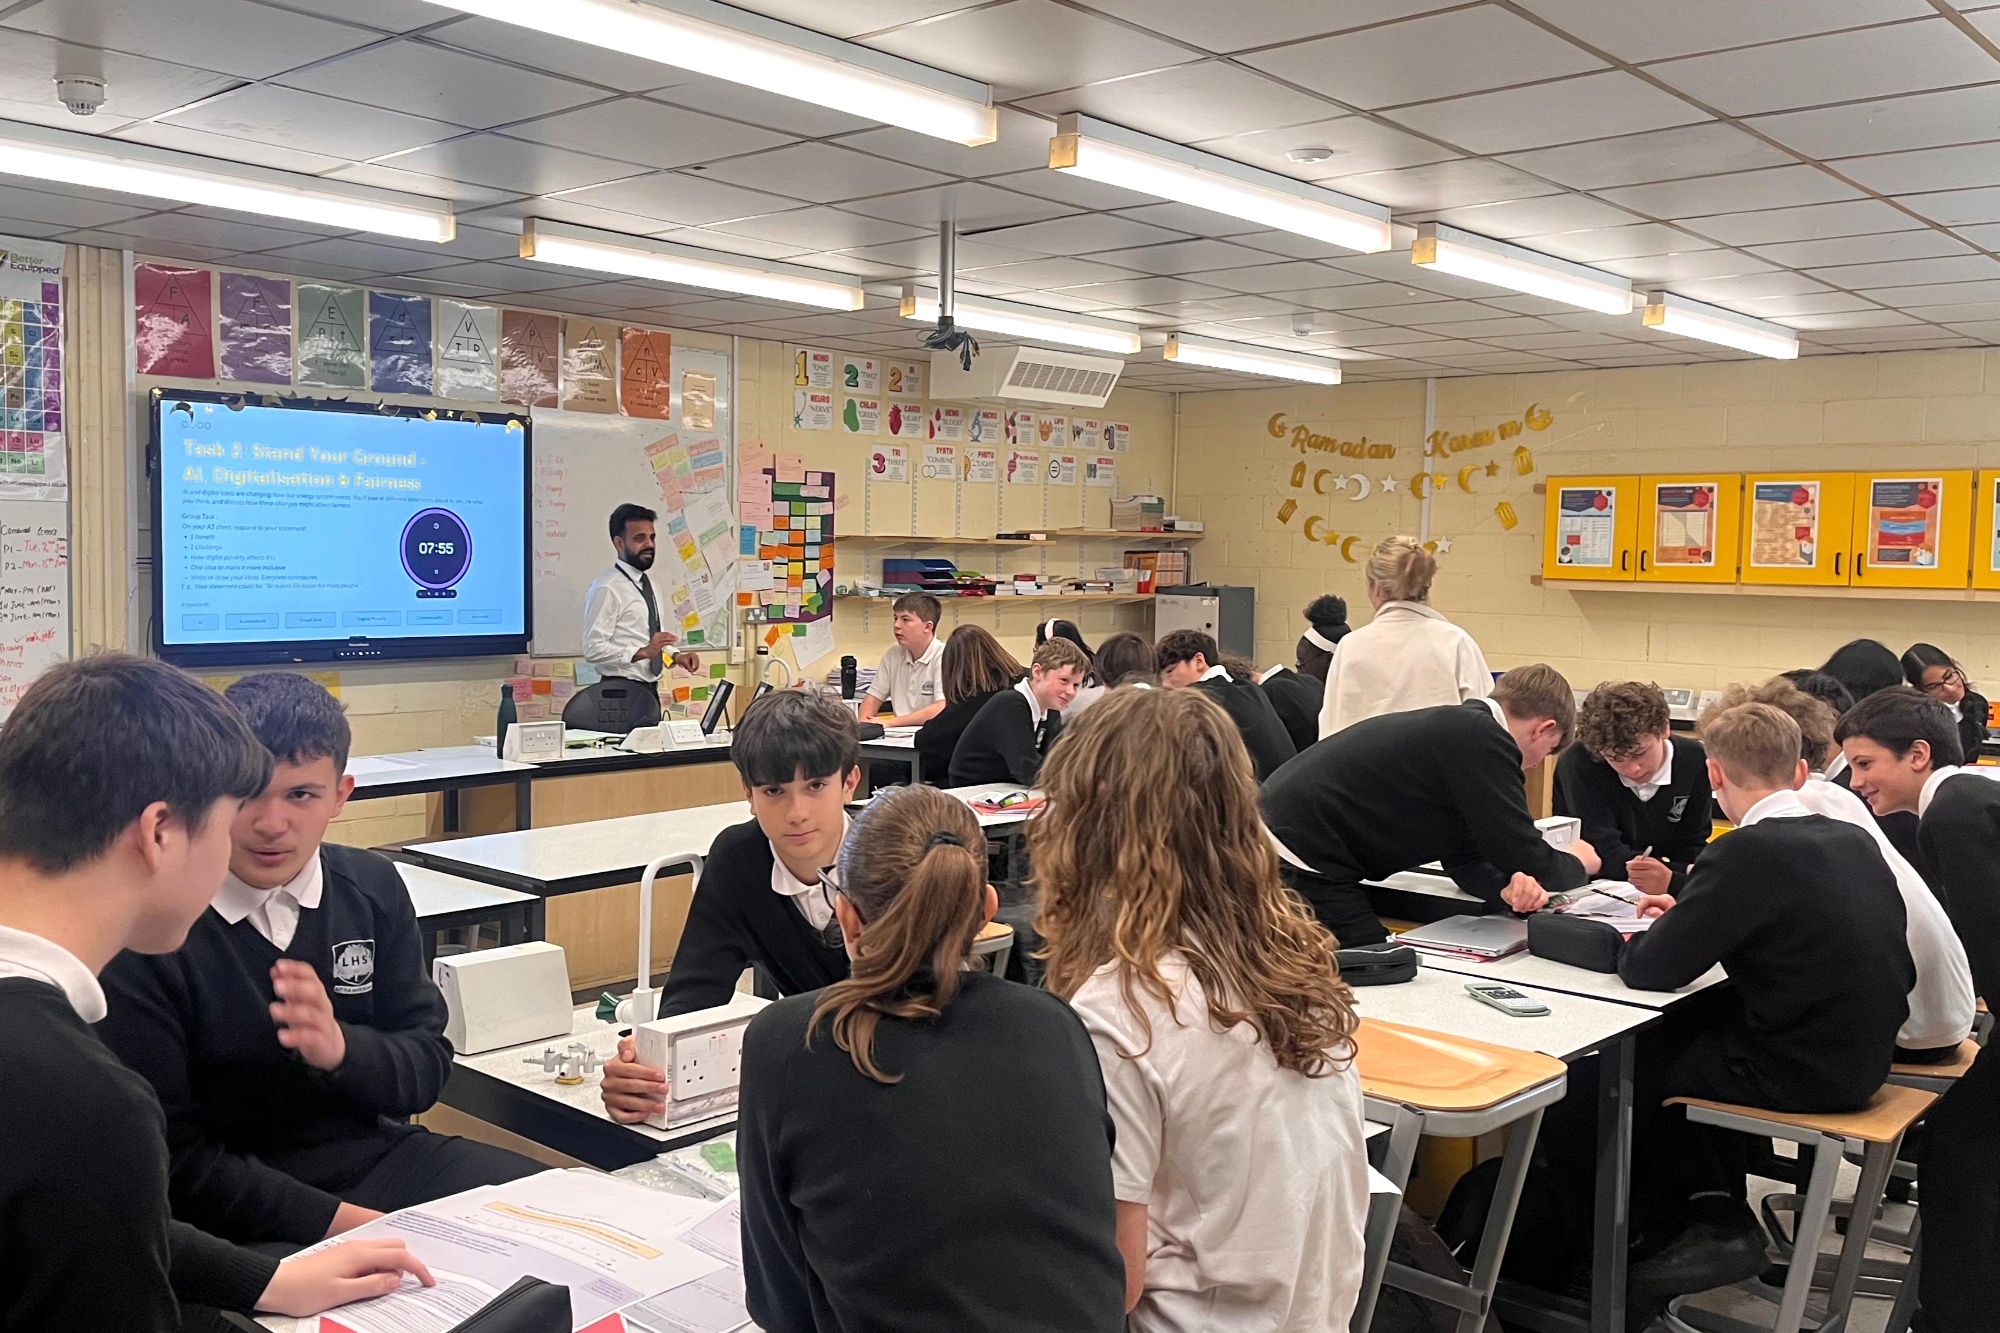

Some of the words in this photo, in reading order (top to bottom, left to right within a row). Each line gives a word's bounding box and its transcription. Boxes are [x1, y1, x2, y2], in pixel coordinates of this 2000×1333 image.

[10, 253, 44, 265] Better
[10, 263, 60, 274] Equipped
[169, 286, 178, 299] F
[253, 296, 261, 309] F
[181, 313, 190, 325] A
[328, 306, 336, 320] E
[398, 311, 406, 322] d
[464, 321, 473, 333] V
[340, 329, 346, 341] t
[537, 352, 545, 363] V
[644, 347, 650, 356] n
[813, 353, 829, 362] MONO
[651, 366, 659, 377] V
[795, 351, 808, 386] 1
[866, 361, 873, 370] DI
[844, 364, 859, 388] 2
[888, 366, 902, 392] 2
[810, 394, 830, 403] NEURO
[859, 401, 878, 409] CHLOR
[904, 405, 921, 413] CARDI
[1290, 424, 1396, 459] Ramadan
[182, 438, 226, 458] Task
[252, 443, 304, 461] Stand
[308, 446, 348, 464] Your
[352, 448, 416, 467] Ground
[935, 446, 953, 455] SYNTH
[977, 451, 994, 459] PHOTO
[872, 453, 886, 474] 3
[182, 465, 207, 484] AI,
[212, 466, 334, 488] Digitalisation
[354, 472, 421, 491] Fairness
[181, 513, 201, 521] Group
[418, 542, 454, 555] 07:55
[343, 955, 368, 967] LHS
